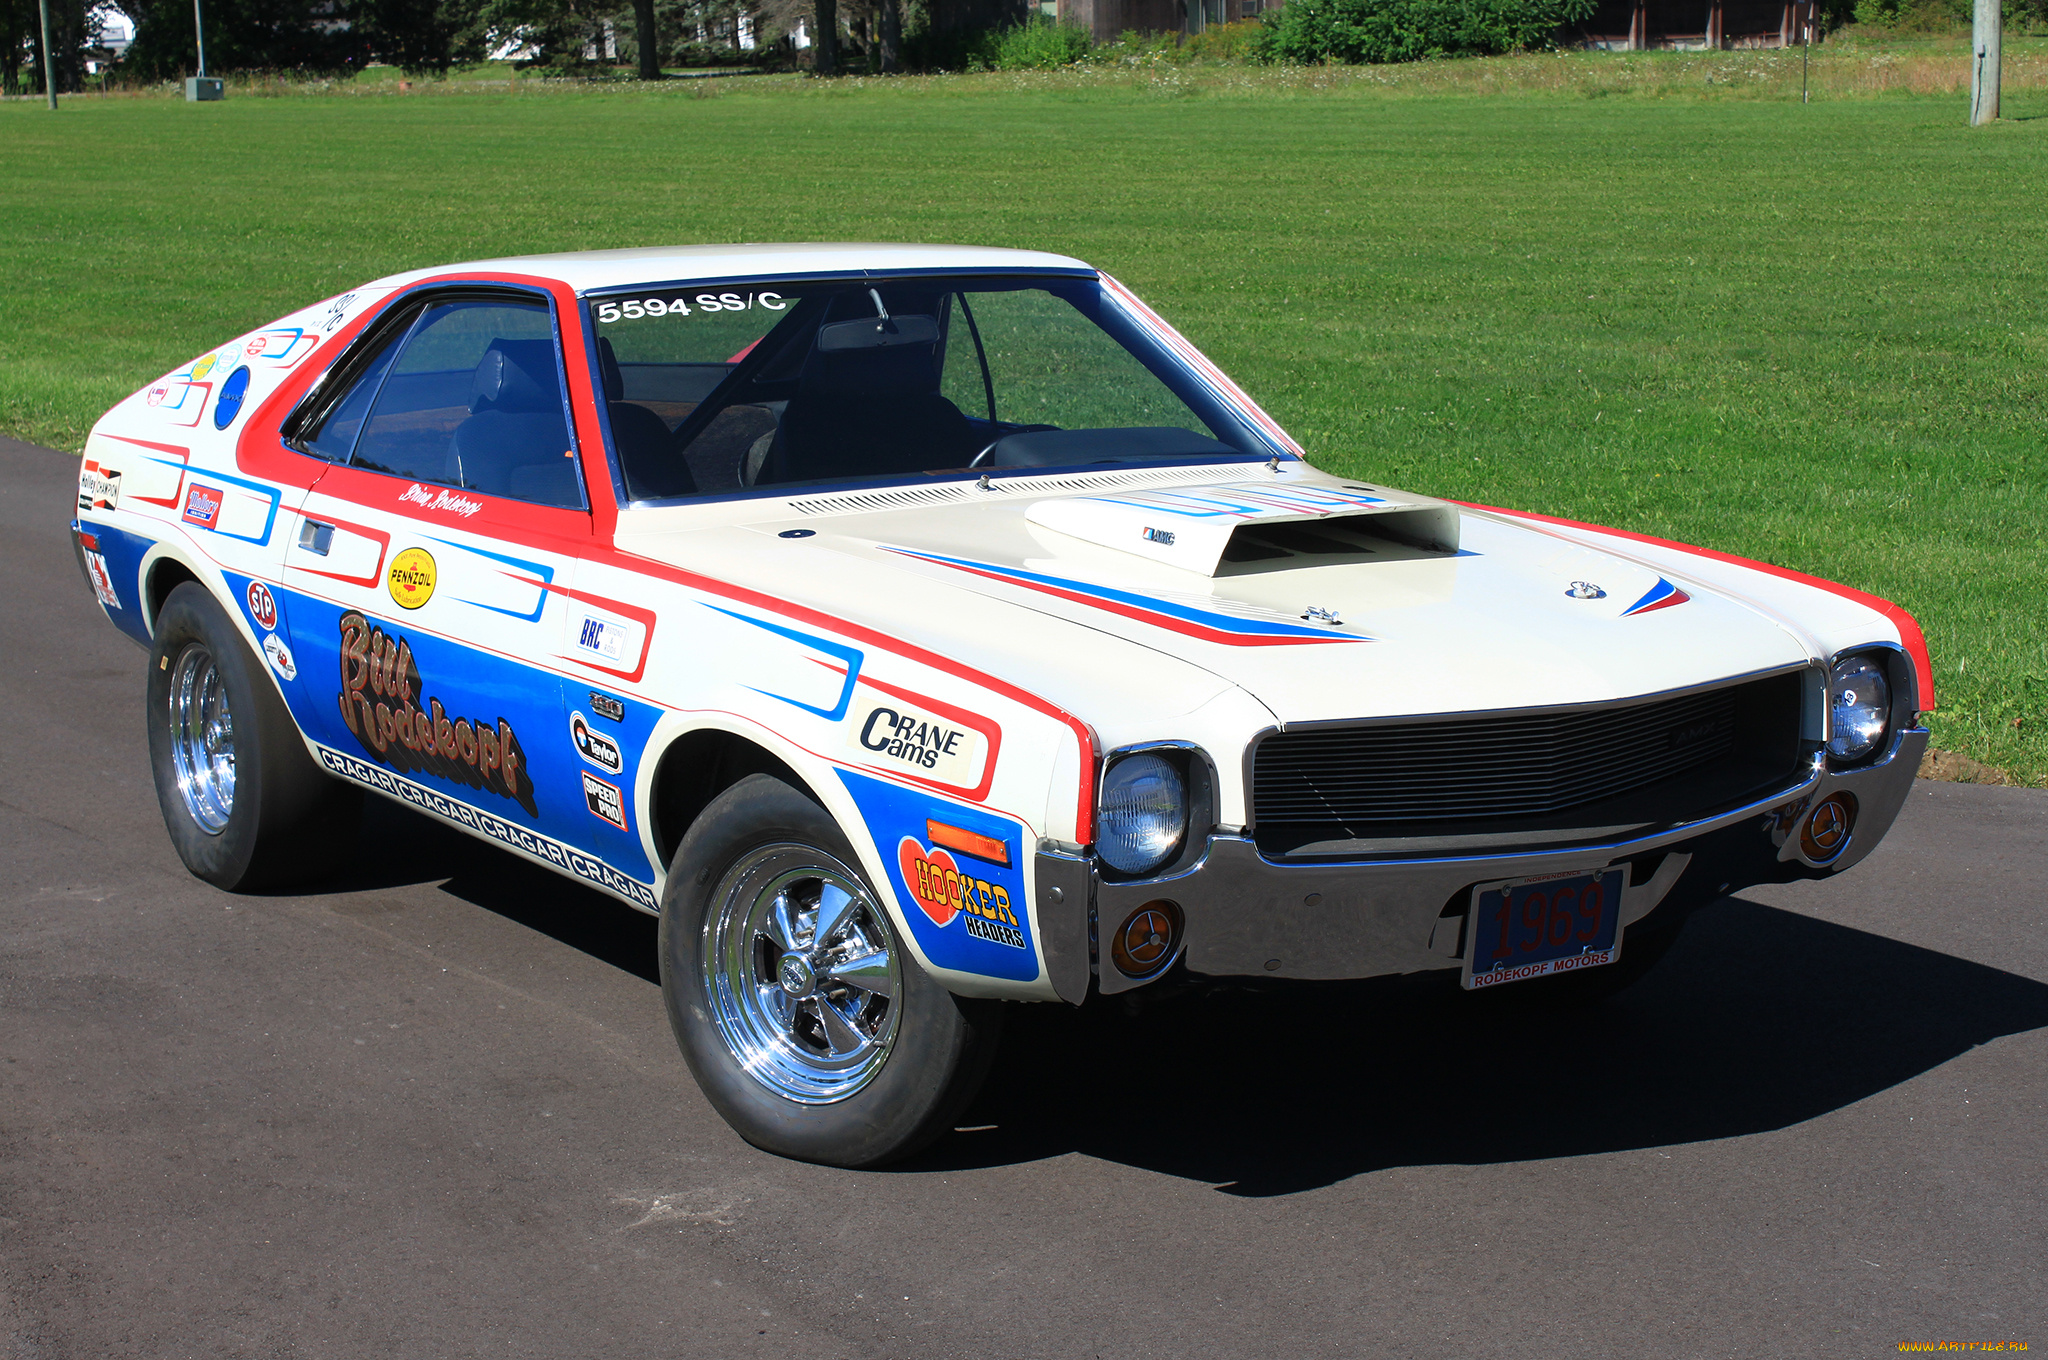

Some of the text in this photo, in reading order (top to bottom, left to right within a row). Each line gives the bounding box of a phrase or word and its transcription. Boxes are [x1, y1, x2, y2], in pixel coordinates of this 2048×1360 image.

[598, 292, 787, 324] 5594 SS/C
[96, 480, 118, 498] CHAMPION
[1153, 529, 1175, 546] AMC
[391, 569, 431, 587] PENNZOIL
[251, 585, 273, 620] STP
[580, 618, 604, 650] BRC
[339, 611, 415, 702] Bill
[338, 690, 521, 795] Rodekopf
[860, 707, 964, 756] CRANE
[588, 736, 617, 763] Taylor
[585, 777, 617, 807] SPEED
[598, 798, 620, 823] PRO
[322, 750, 393, 793] CRAGAR
[398, 781, 475, 828] CRAGAR
[480, 816, 565, 866] CRAGAR
[571, 854, 654, 909] CRAGAR
[915, 857, 1019, 927] HOOKER
[1524, 870, 1581, 883] INDEPENDENCE
[965, 915, 1026, 949] HEADERS
[1492, 881, 1604, 959] 1969
[1474, 952, 1609, 987] RODEKOPF MOTORS
